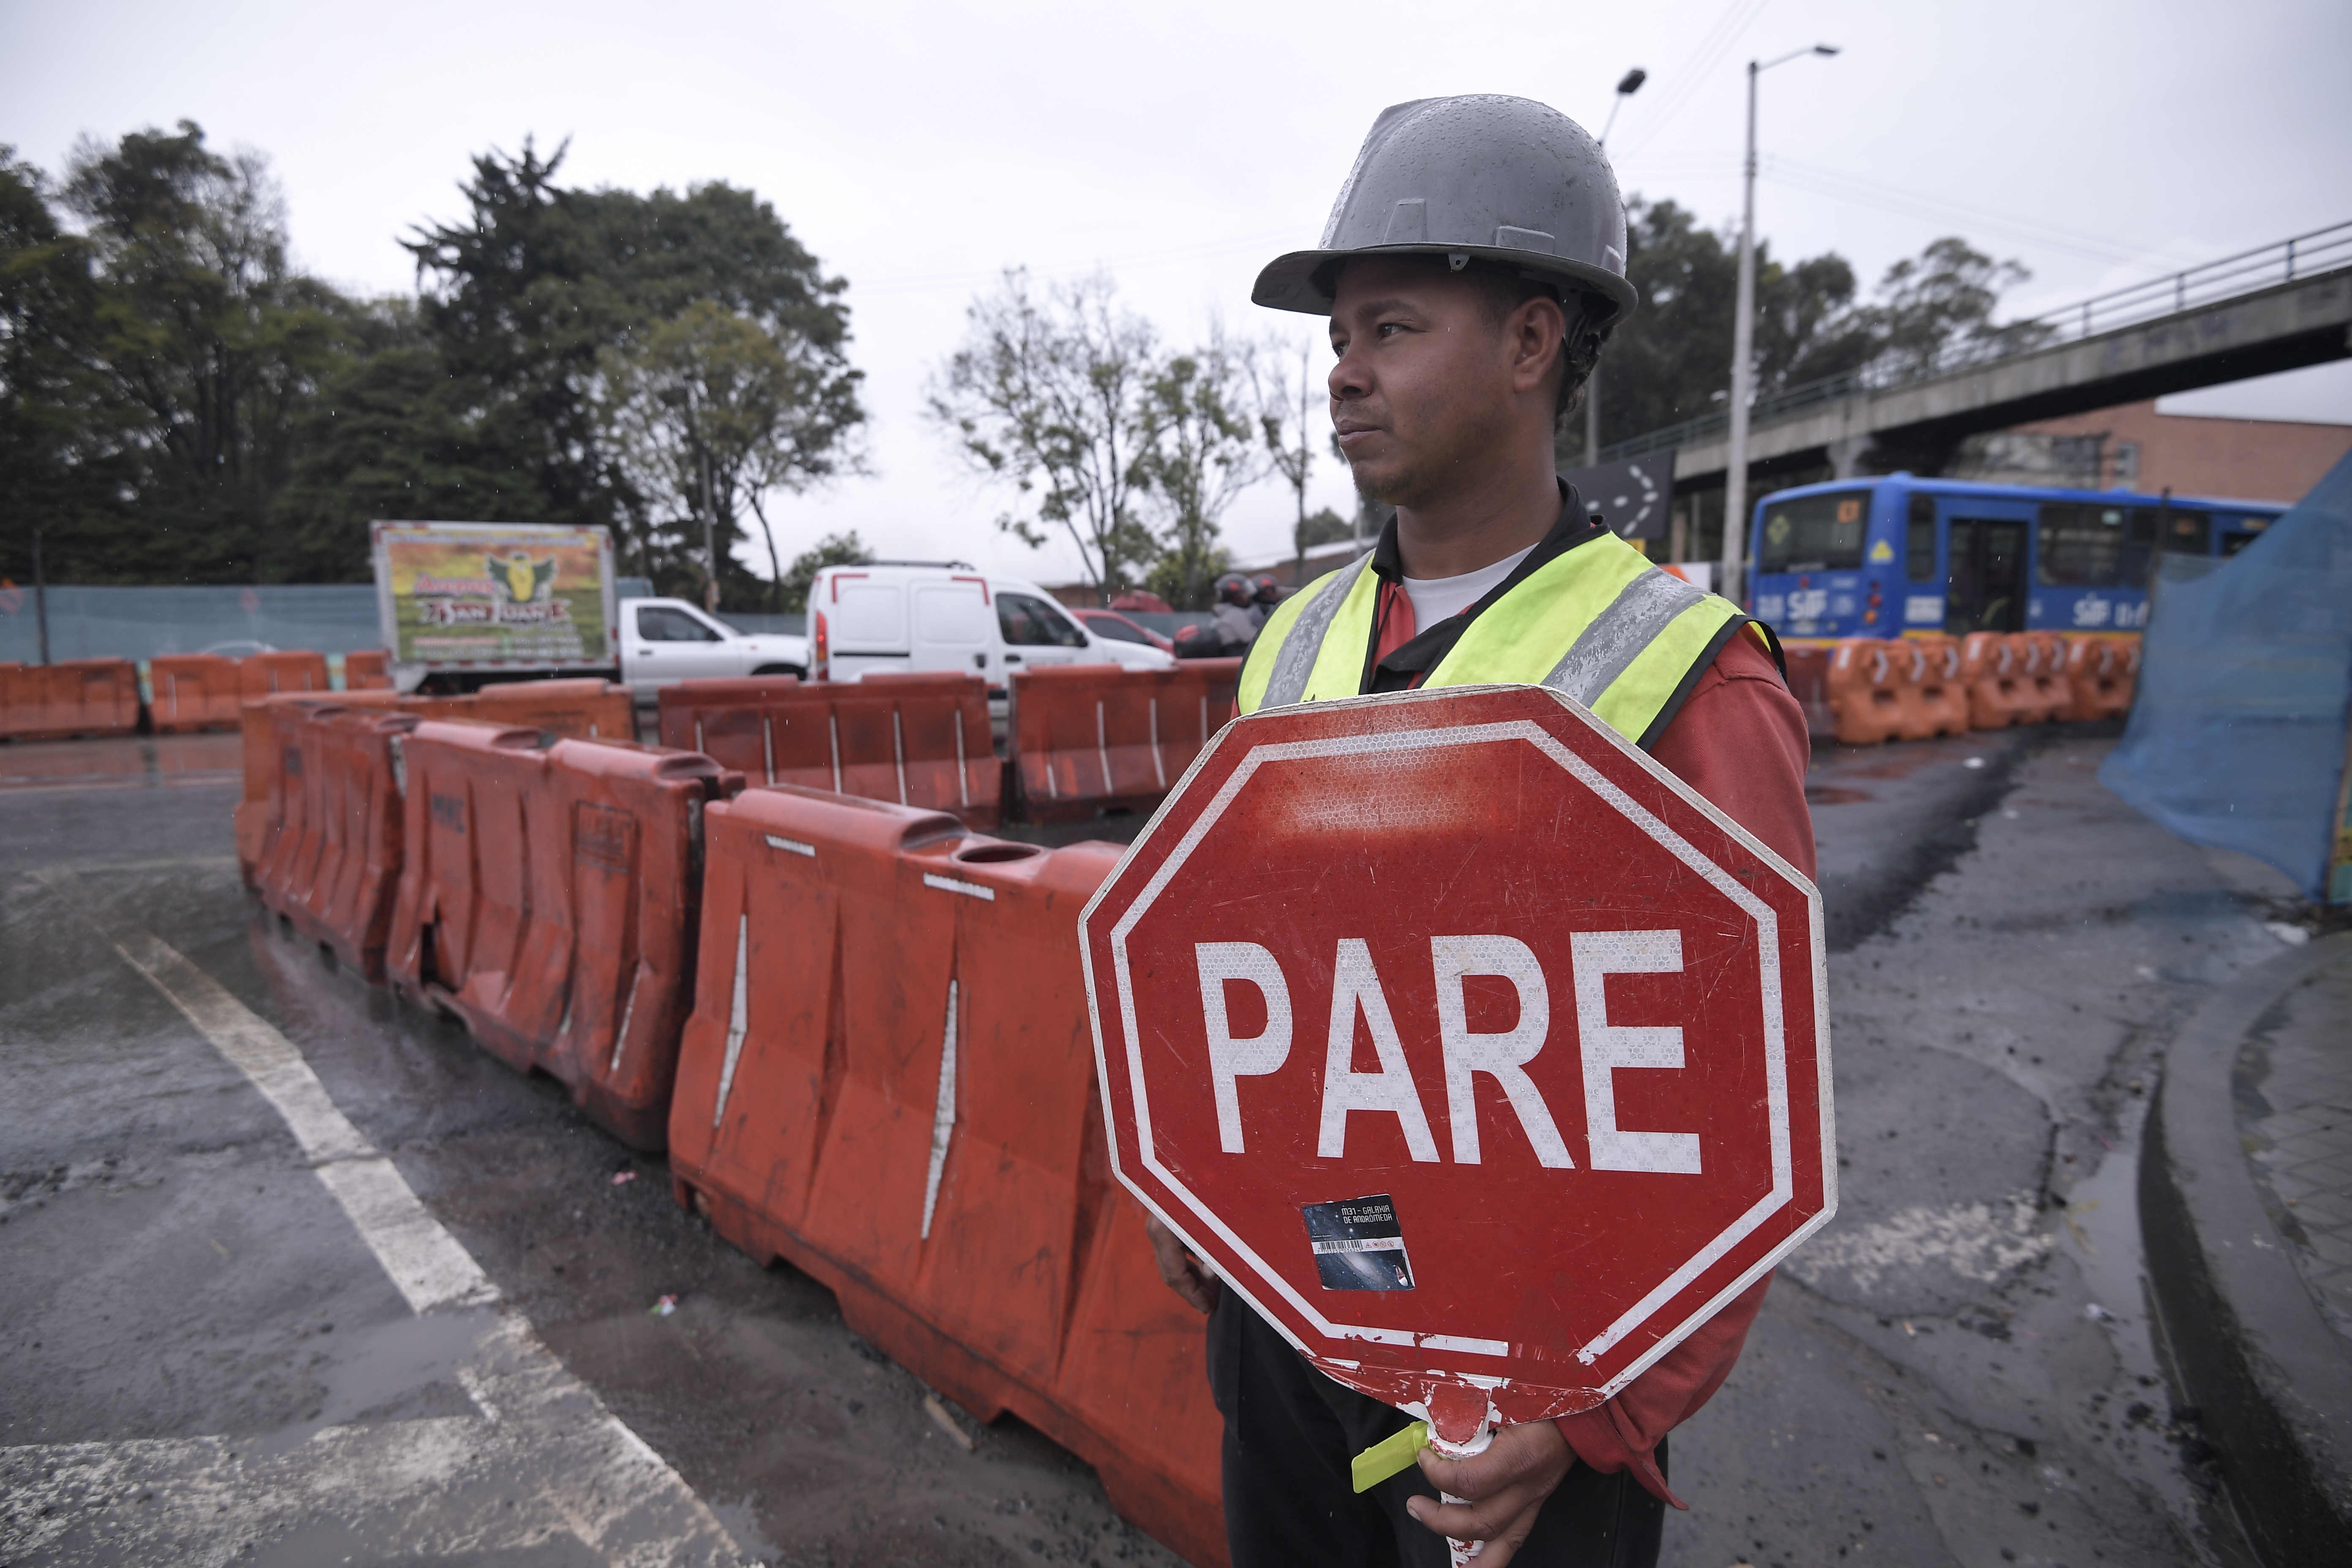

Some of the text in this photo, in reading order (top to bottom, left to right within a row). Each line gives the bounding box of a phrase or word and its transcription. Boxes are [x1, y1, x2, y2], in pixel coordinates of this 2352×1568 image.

[1195, 929, 1701, 1174] PARE
[1362, 1205, 1390, 1214] GALAXIA
[1353, 1213, 1393, 1223] ANDRÓMEDA
